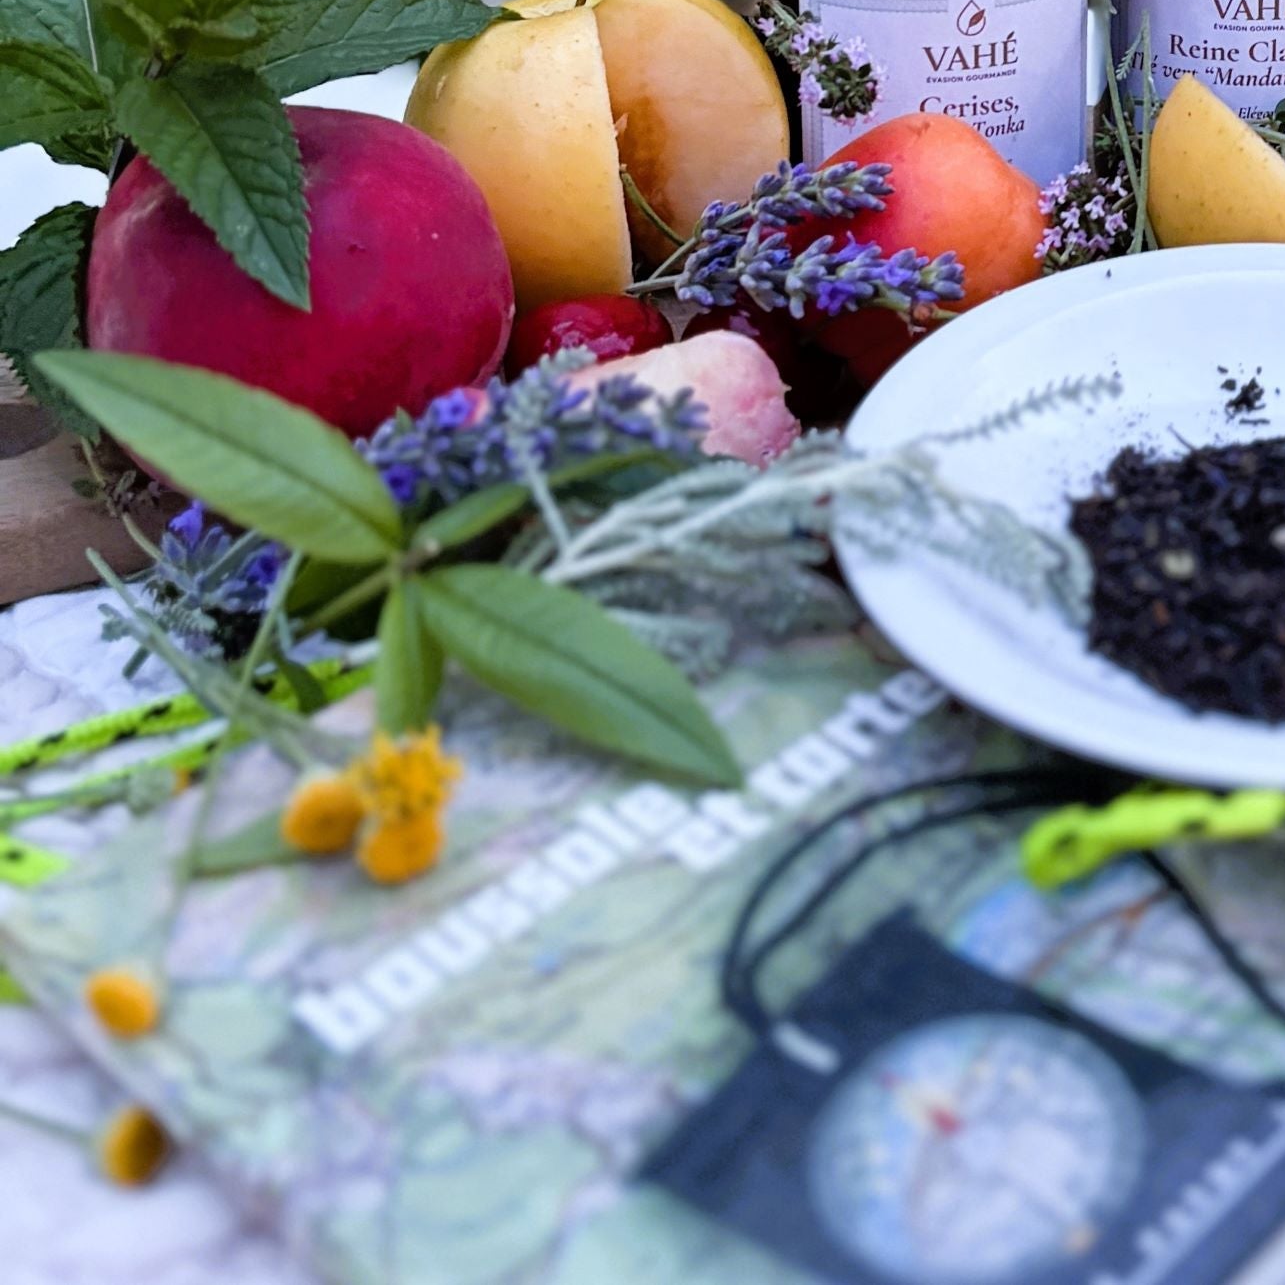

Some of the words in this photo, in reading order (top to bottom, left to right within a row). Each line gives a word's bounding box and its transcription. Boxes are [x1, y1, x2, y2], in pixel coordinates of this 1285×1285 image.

[1214, 23, 1247, 32] ÉVASION
[922, 31, 1018, 72] VAHÉ
[1169, 34, 1239, 63] Reine
[926, 75, 964, 83] ÉVASION
[966, 69, 1016, 82] GOURMANDE
